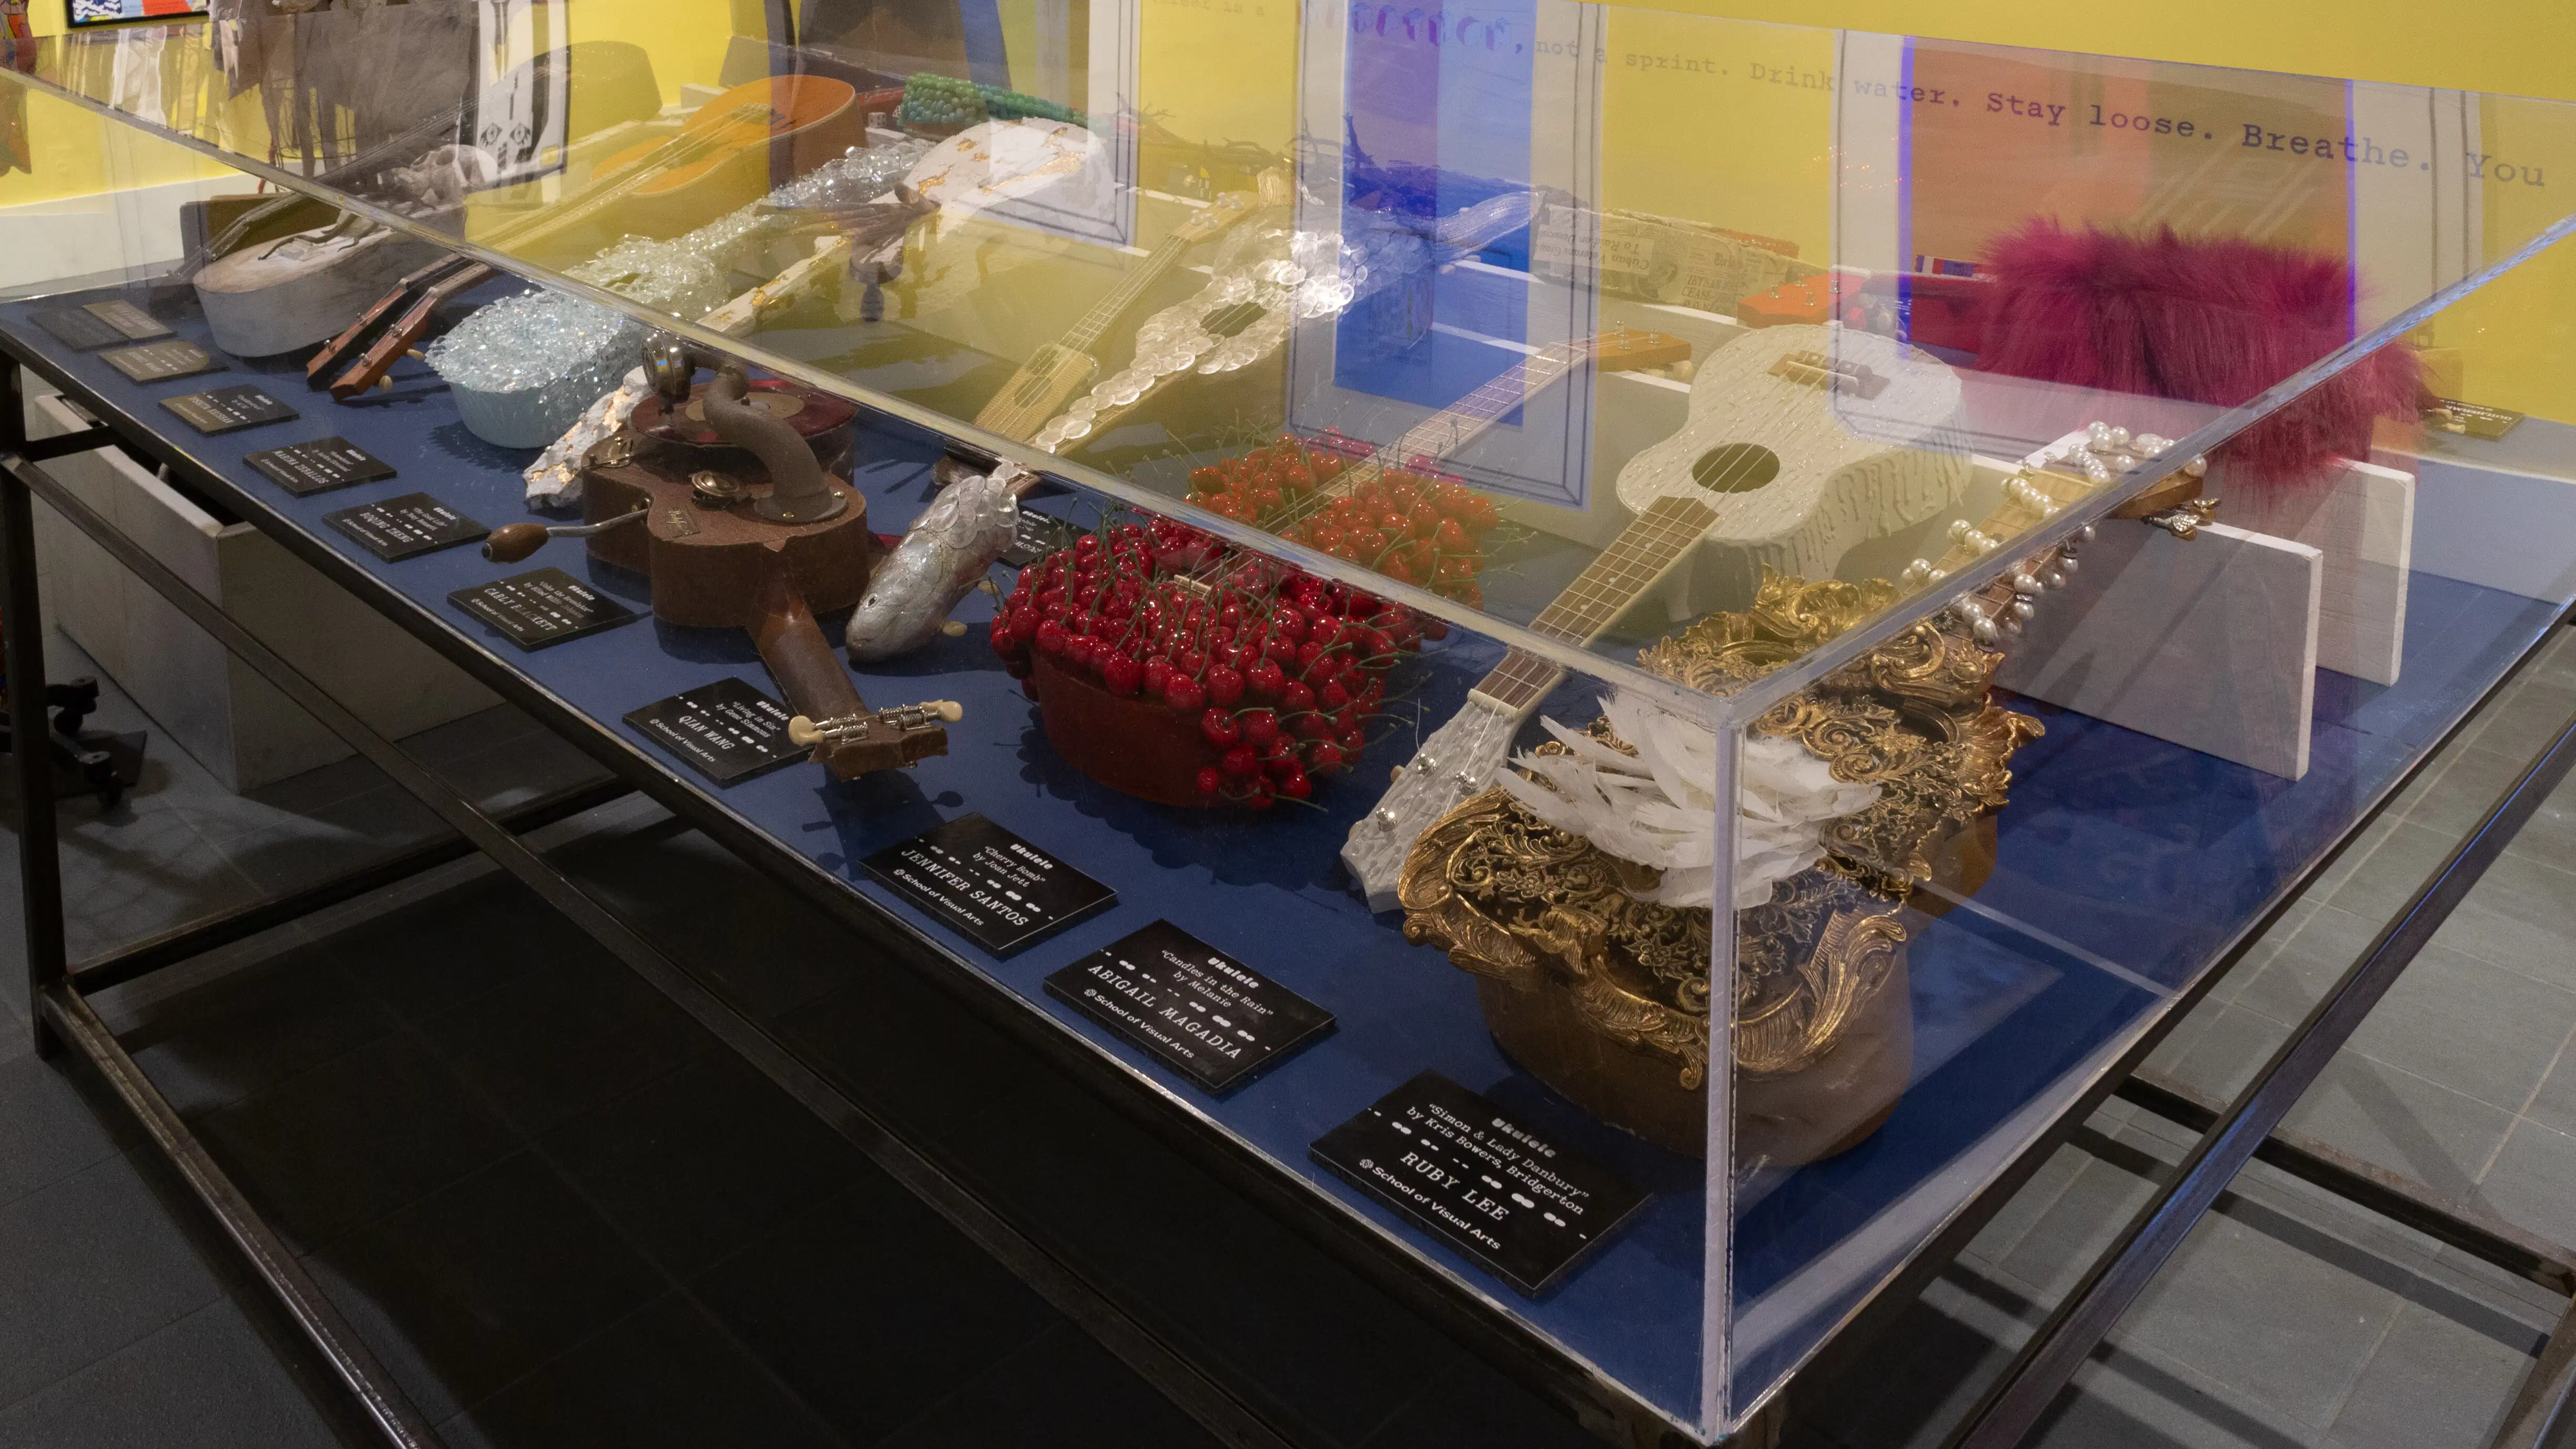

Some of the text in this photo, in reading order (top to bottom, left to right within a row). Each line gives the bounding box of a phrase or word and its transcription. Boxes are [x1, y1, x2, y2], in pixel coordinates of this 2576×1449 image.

[1535, 40, 1579, 58] not
[1625, 53, 1728, 76] sprint.
[1750, 63, 1835, 91] Drink
[1854, 79, 1960, 107] water.
[1987, 92, 2065, 126] Stay
[2090, 104, 2213, 140] loose.
[2242, 124, 2429, 171] Breathe.
[2466, 152, 2545, 187] You
[485, 588, 515, 605] CARLY
[725, 708, 742, 720] Gene
[740, 717, 772, 738] Simmons
[754, 714, 764, 722] in
[756, 701, 789, 721] Ukulele
[655, 722, 678, 739] School
[683, 738, 704, 755] Visual
[700, 750, 716, 762] Arts
[679, 716, 735, 750] QIAN WANG
[973, 852, 1030, 889] by Joan Jett
[984, 846, 1046, 883] "Cherry Bomb"
[1010, 843, 1053, 870] Ukulele
[901, 849, 1029, 926] JENNIFER SANTOS
[902, 874, 984, 926] School of Visual Arts
[1162, 950, 1274, 1016] "Candles in the Rain"
[1173, 971, 1231, 1008] by Melanie
[1208, 957, 1260, 988] Ukulele
[1088, 965, 1242, 1060] ABIGAIL MAGADIA
[1094, 994, 1194, 1059] School of Visual Arts
[1429, 1103, 1589, 1199] "Simon & Lady Danbury"
[1492, 1118, 1556, 1157] Ukulele
[1406, 1106, 1584, 1215] by Kris Bowers, Bridgerton
[1400, 1151, 1510, 1221] RUBY LEE
[1372, 1167, 1501, 1250] School of Visual Arts
